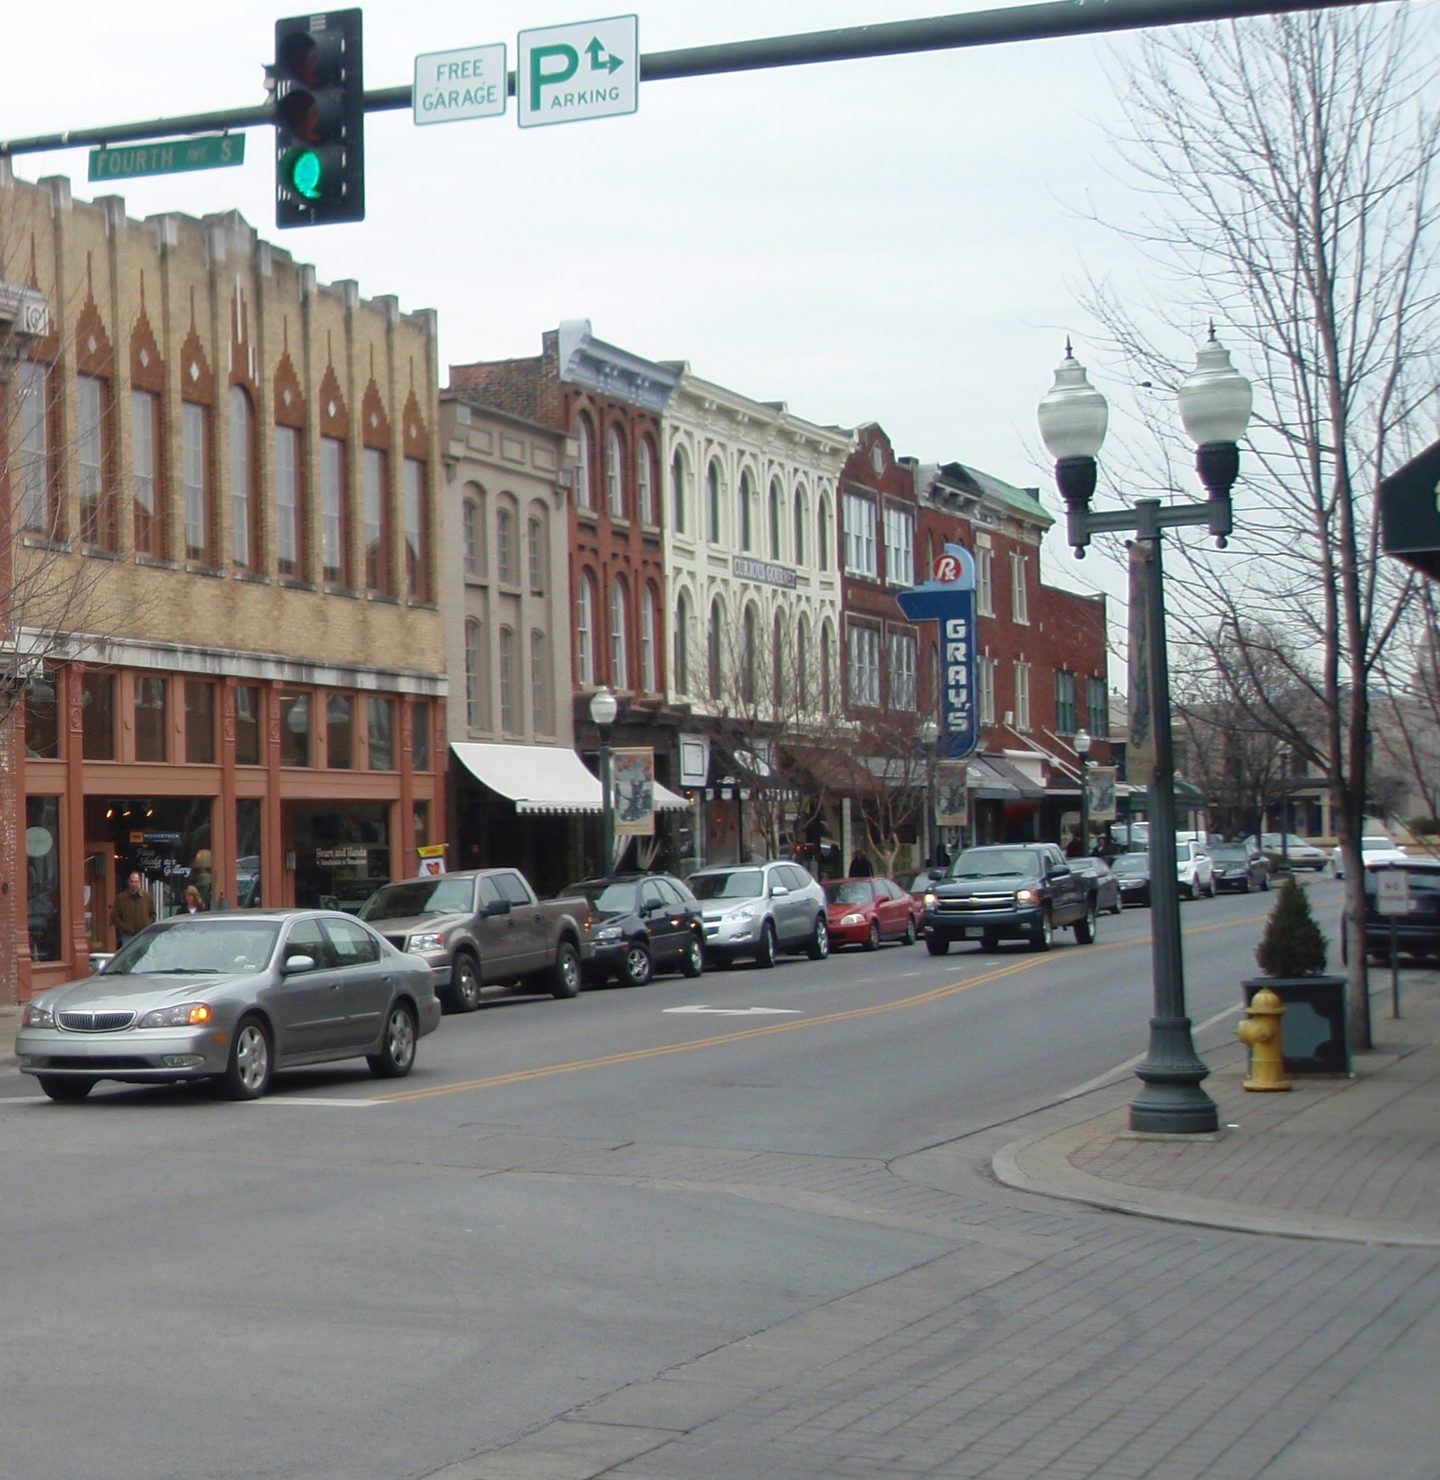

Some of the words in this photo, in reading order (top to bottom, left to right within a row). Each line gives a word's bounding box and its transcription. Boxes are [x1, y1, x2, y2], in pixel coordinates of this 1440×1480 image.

[436, 59, 484, 82] FREE
[422, 85, 497, 111] GARAGE
[97, 147, 174, 176] FOURTH
[220, 139, 233, 162] S
[946, 618, 972, 732] GRAY'S
